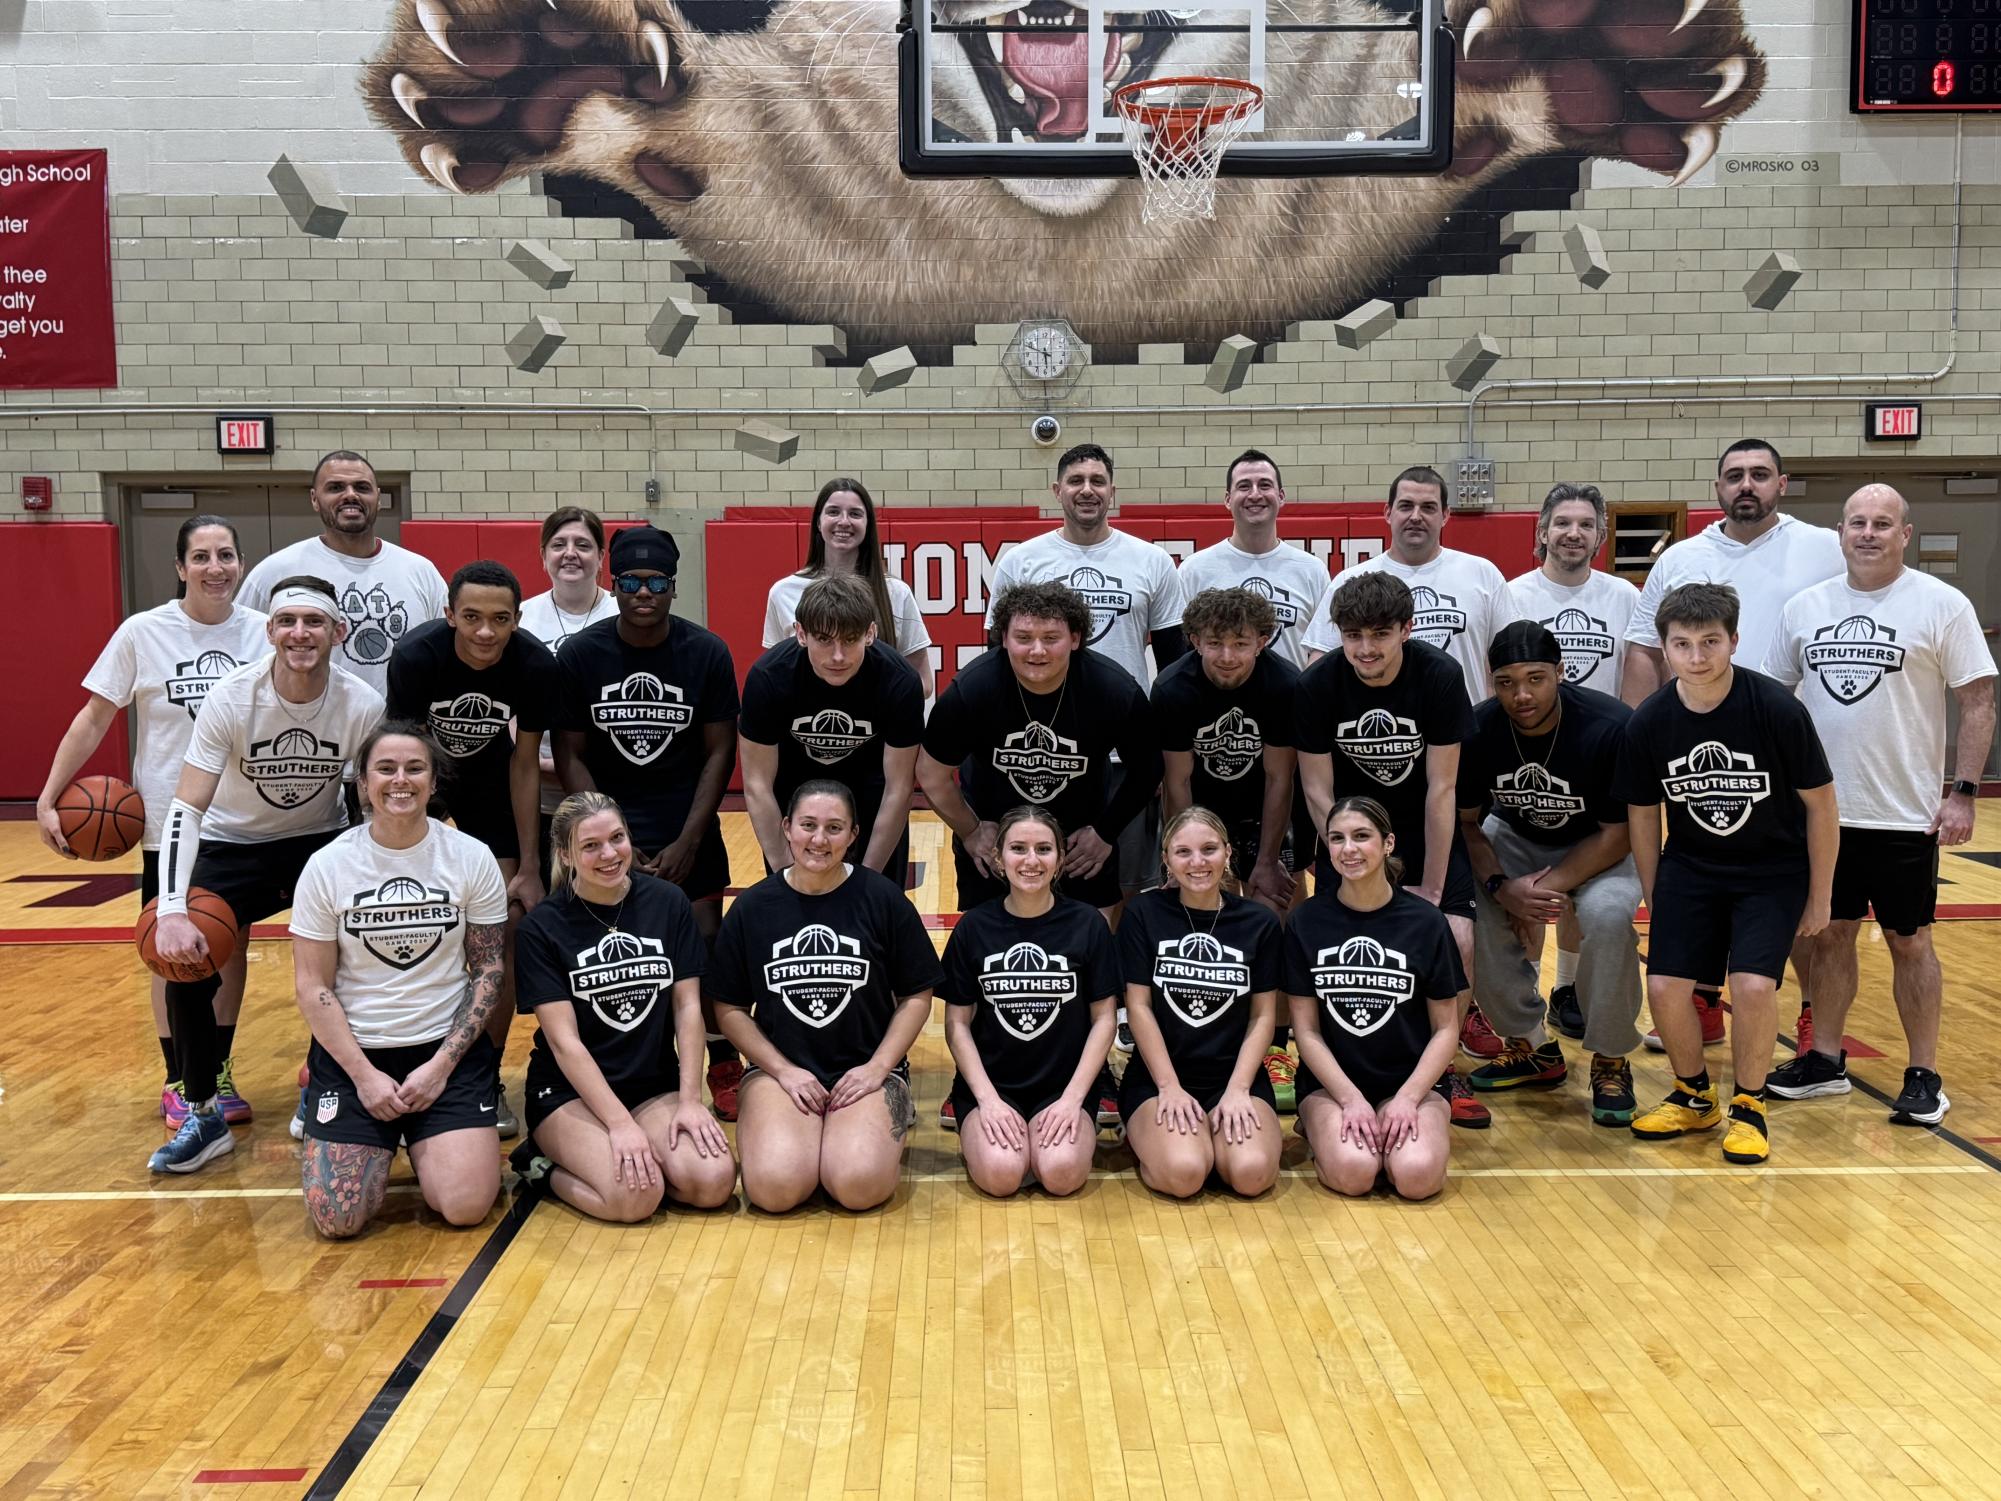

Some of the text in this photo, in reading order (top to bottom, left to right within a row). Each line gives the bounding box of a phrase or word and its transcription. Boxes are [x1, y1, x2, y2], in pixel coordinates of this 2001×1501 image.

[1933, 63, 1953, 95] 0
[27, 163, 91, 181] School
[1801, 160, 1819, 172] 03
[0, 216, 29, 233] ter
[4, 266, 47, 283] thee
[0, 291, 36, 312] alty
[29, 319, 64, 337] you
[1882, 409, 1914, 434] EXIT
[226, 422, 260, 447] EXIT
[1085, 595, 1125, 605] THERS
[347, 594, 403, 634] ATS
[1413, 614, 1460, 626] UTHERS
[1556, 637, 1609, 649] UTHERS
[1810, 648, 1896, 661] STRUTHERS
[599, 708, 685, 720] STRUTHERS
[431, 717, 501, 734] TRUTHER
[247, 763, 340, 775] STRUTHERS
[1000, 754, 1080, 769] STRUTHERS
[1671, 777, 1761, 793] STRUTHERS
[351, 907, 453, 924] STRUTHERS
[578, 963, 668, 988] STRUTHERS
[772, 963, 862, 980] STRUTHERS
[1158, 963, 1245, 983] STRUTHERS
[984, 978, 1071, 991] STRUTHERS
[1314, 973, 1408, 990] STRUTHERS
